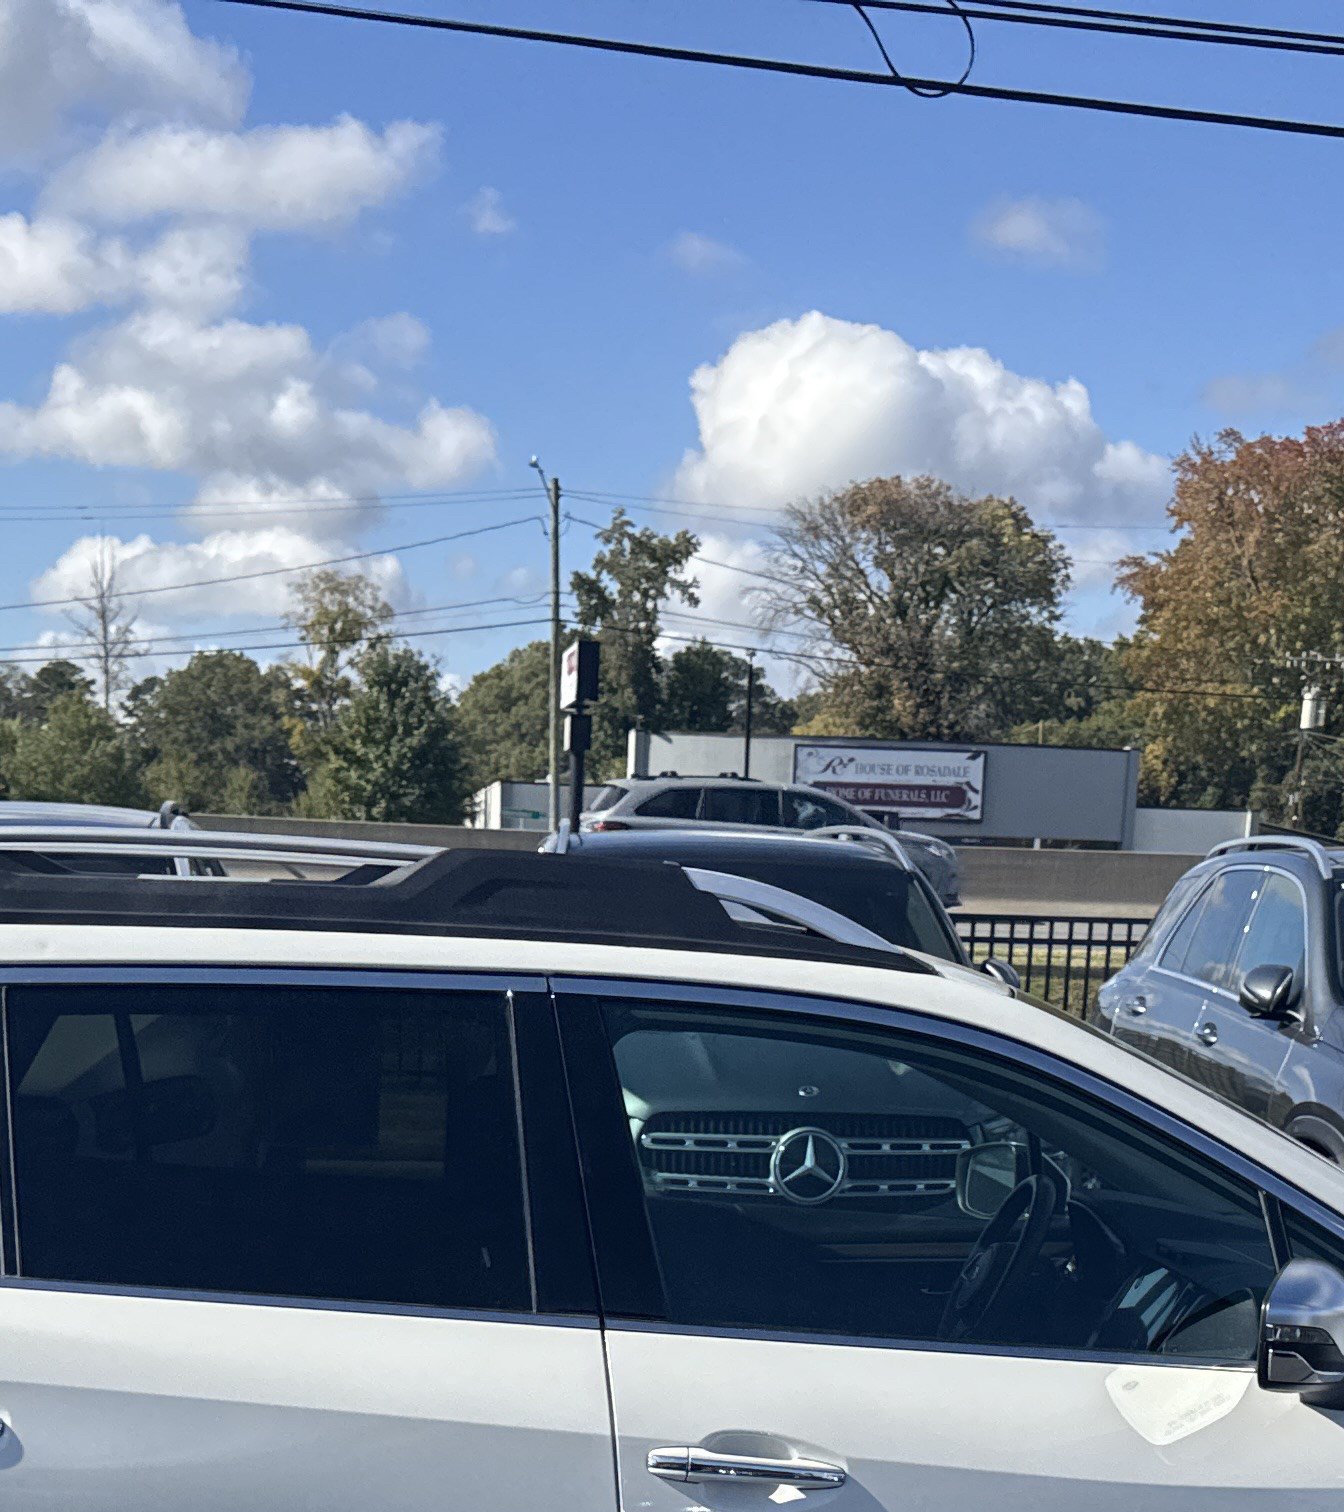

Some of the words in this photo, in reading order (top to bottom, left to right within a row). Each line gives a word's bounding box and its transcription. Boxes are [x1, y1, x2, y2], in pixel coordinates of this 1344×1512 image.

[855, 763, 894, 775] HOUSE
[895, 764, 913, 776] OF
[857, 788, 873, 800] OF
[930, 790, 951, 802] LLC
